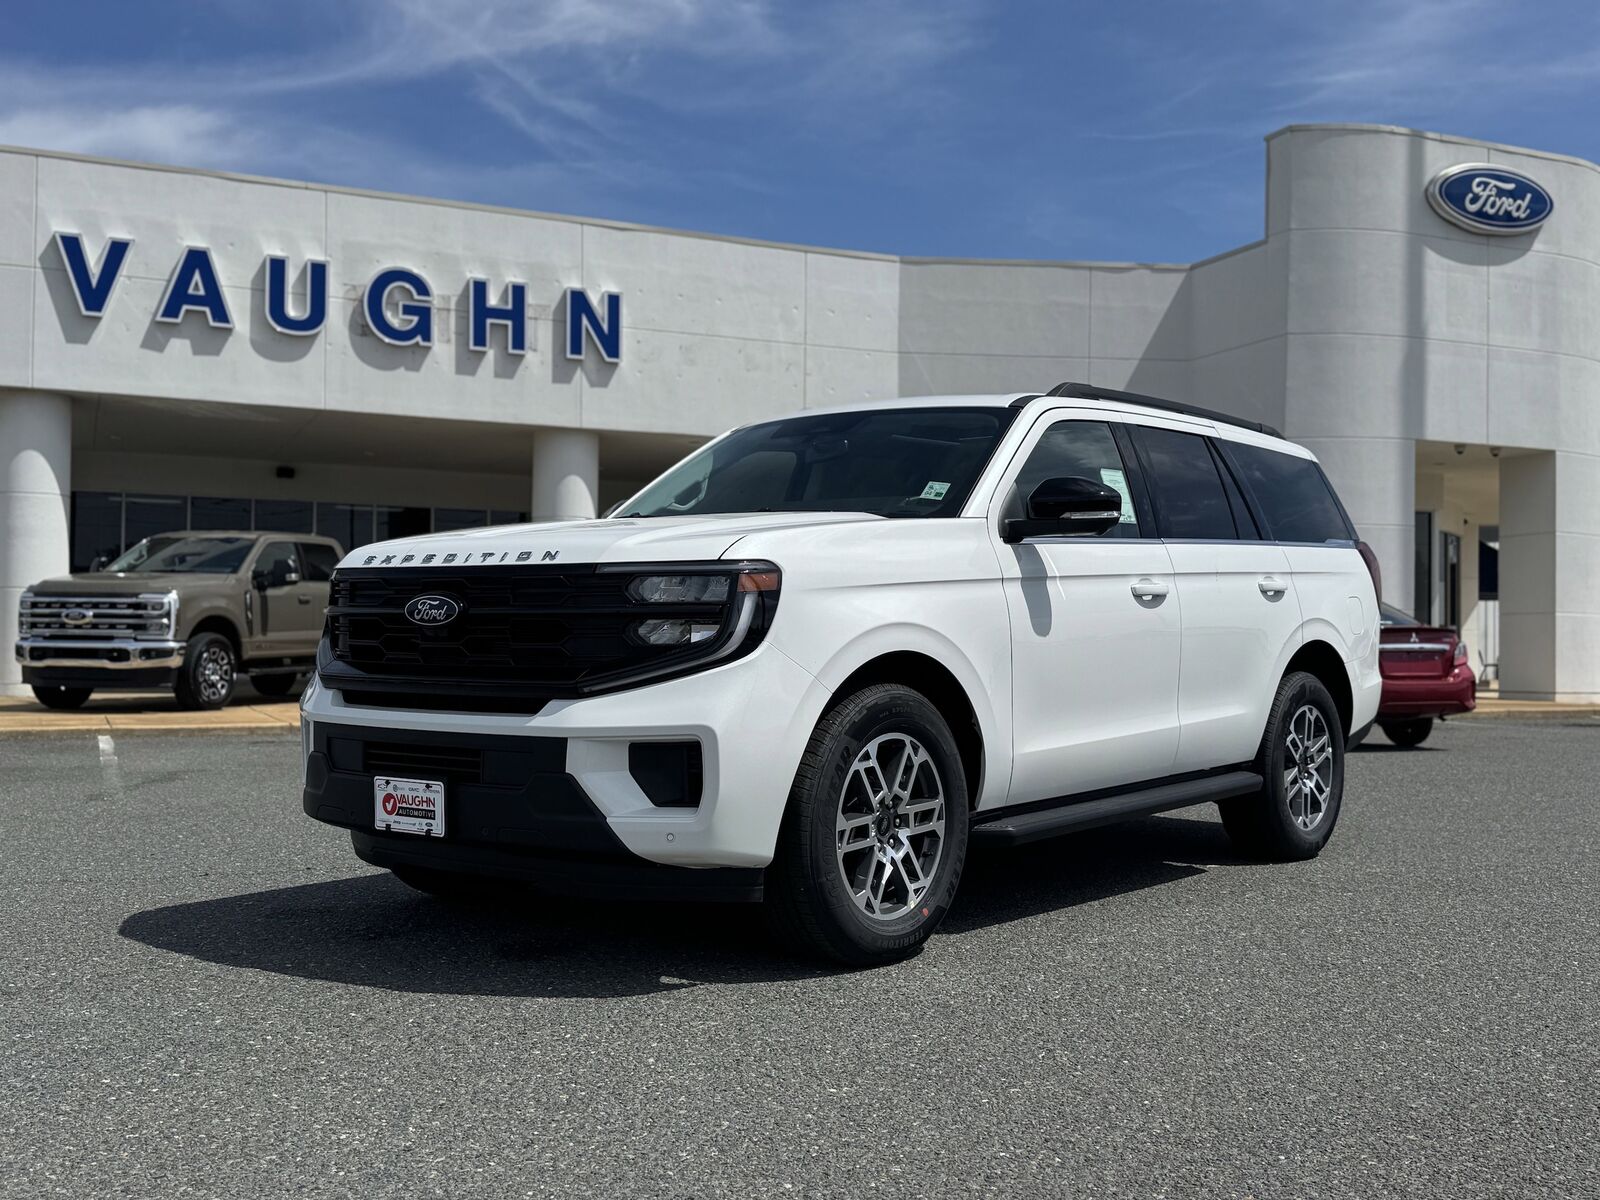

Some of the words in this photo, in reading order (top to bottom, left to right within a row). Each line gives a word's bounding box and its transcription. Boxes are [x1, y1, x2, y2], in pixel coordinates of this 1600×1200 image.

[1464, 176, 1533, 219] Ford
[53, 231, 623, 363] VAUGHN
[362, 550, 560, 566] EXPEDITION
[414, 599, 448, 621] Ford
[396, 794, 435, 808] VAUGHN
[398, 809, 434, 818] AUTOMOTIVE
